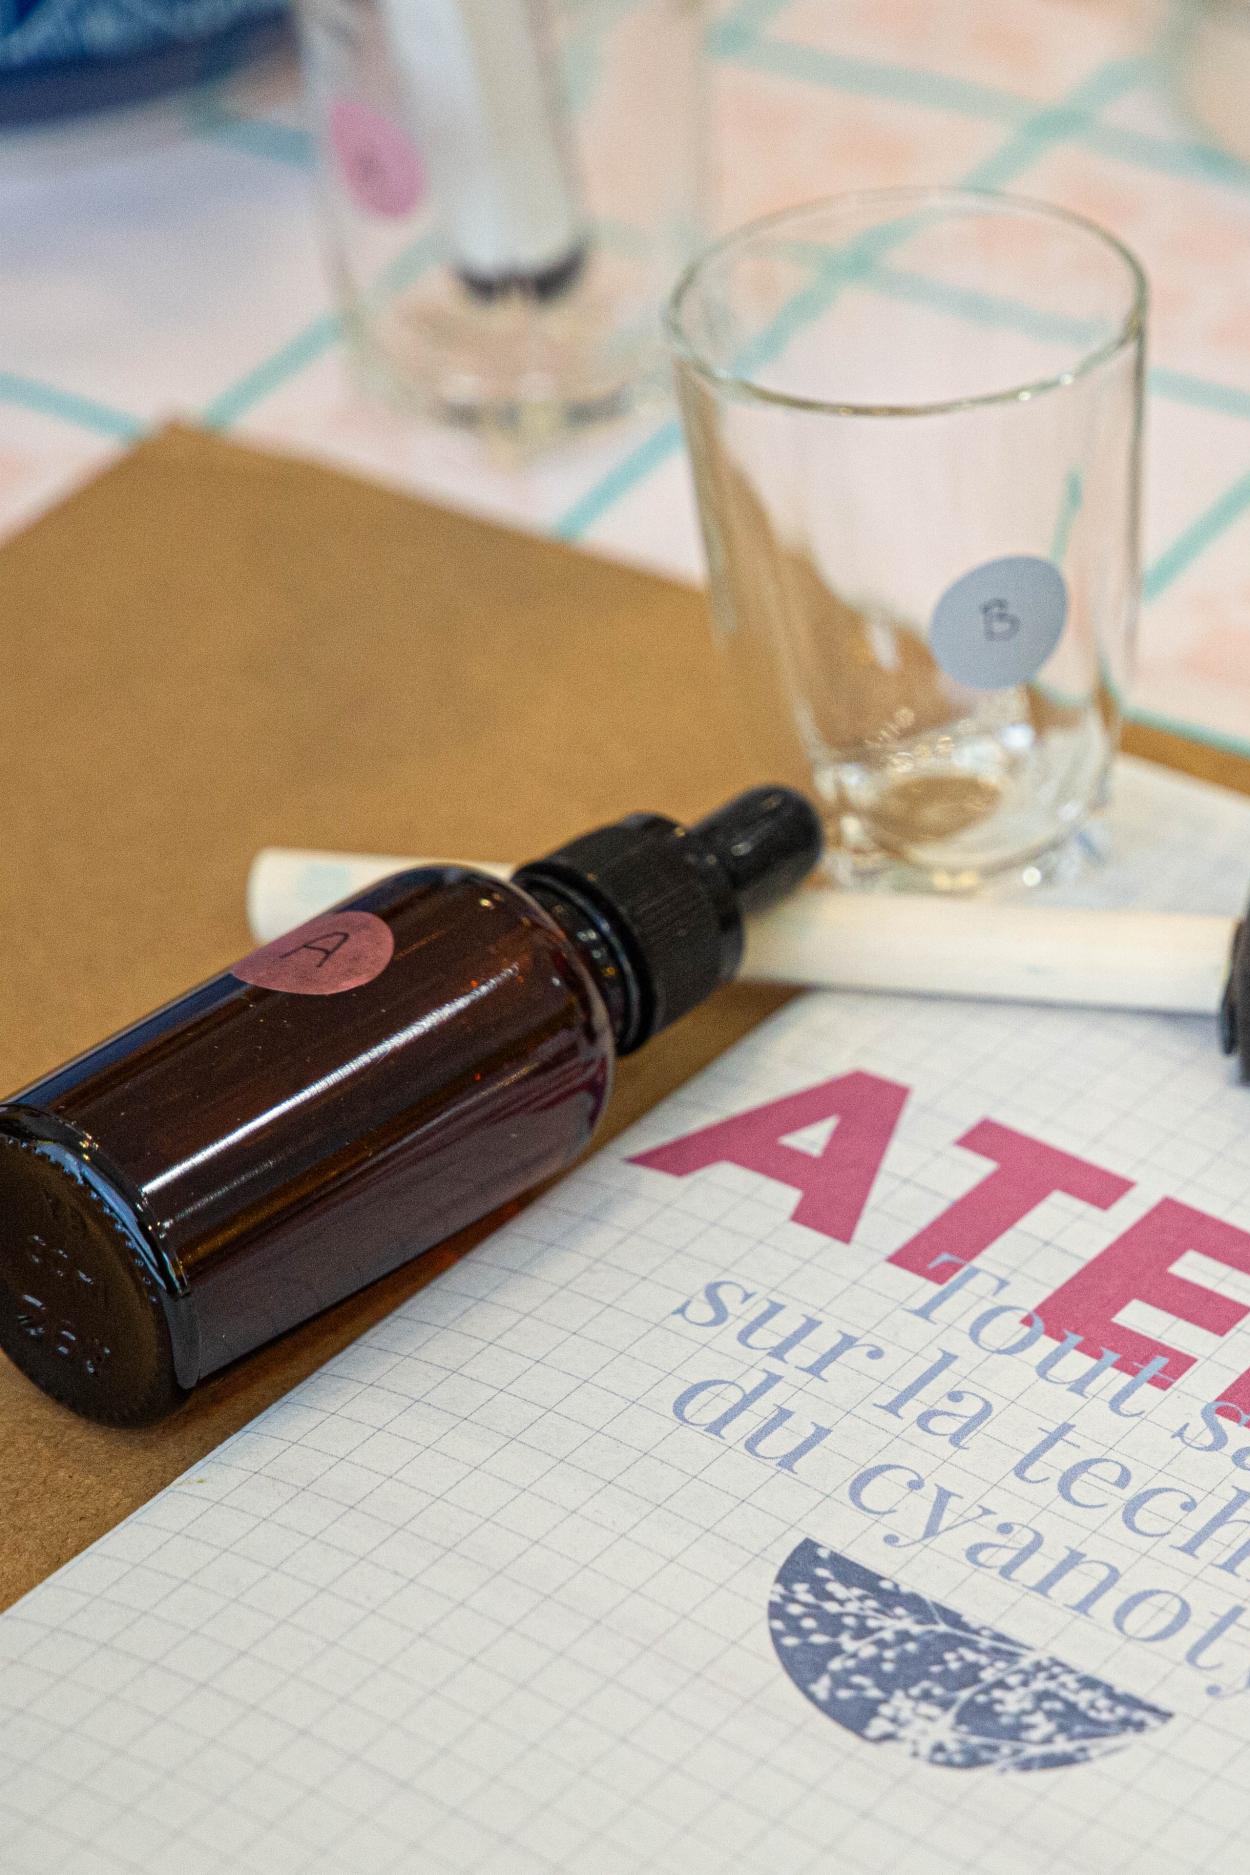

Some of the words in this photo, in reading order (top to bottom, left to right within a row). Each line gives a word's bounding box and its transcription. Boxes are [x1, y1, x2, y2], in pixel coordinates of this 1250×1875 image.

[980, 598, 1020, 641] B
[279, 931, 349, 968] A
[672, 1280, 884, 1382] sur
[872, 1348, 993, 1450] la
[903, 1252, 1176, 1418] Tout
[672, 1368, 833, 1474] du
